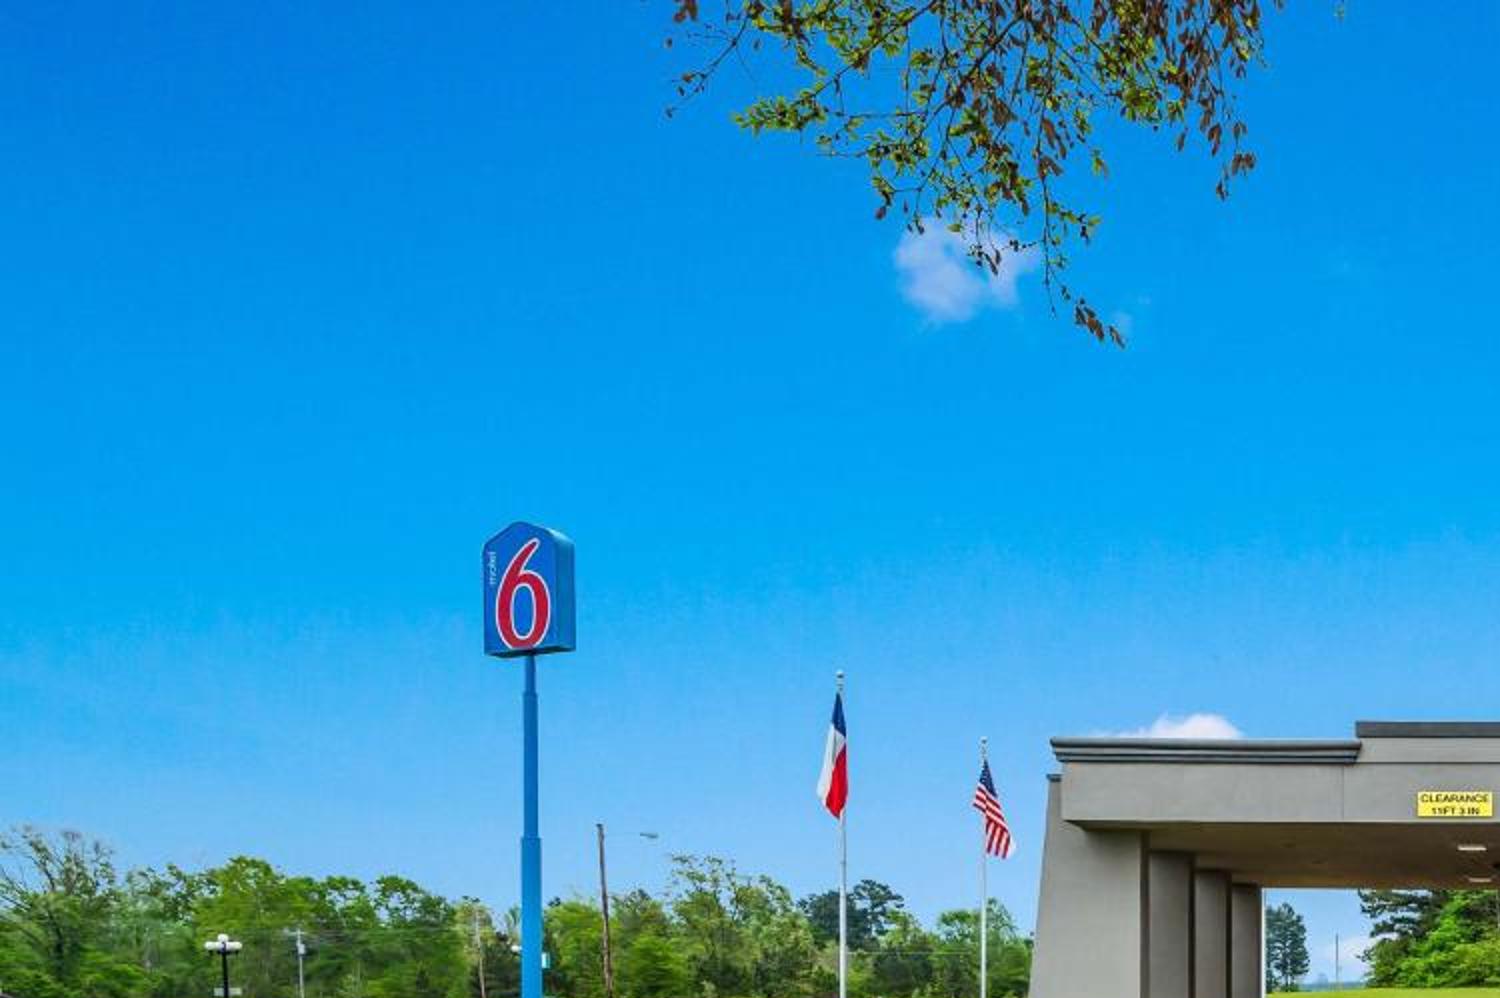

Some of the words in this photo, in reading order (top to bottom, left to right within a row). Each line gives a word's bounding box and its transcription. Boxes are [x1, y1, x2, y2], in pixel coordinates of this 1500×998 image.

[495, 537, 551, 649] 6
[1420, 794, 1488, 803] CLEARANCE
[1467, 807, 1480, 815] IN
